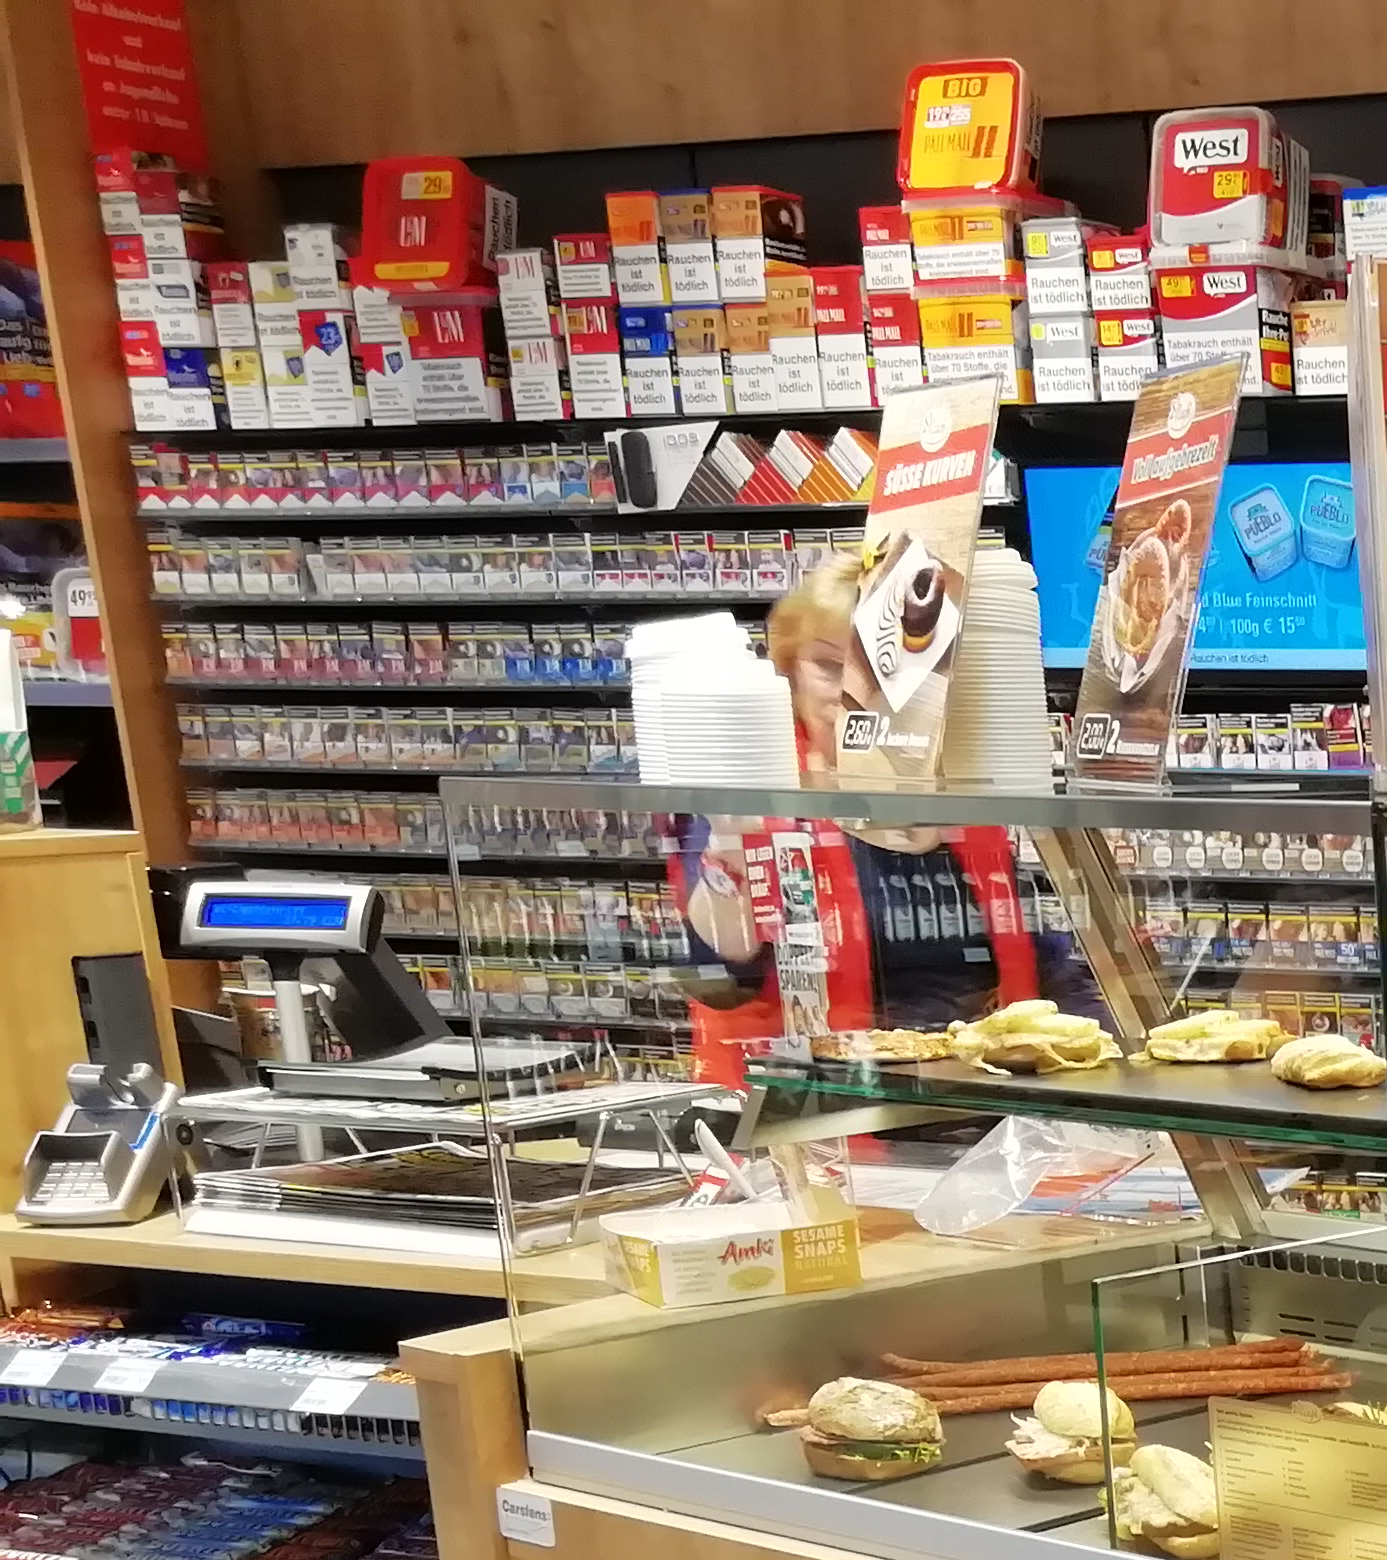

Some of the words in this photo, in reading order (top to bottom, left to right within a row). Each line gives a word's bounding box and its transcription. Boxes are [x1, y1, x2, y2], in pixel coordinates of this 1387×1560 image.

[948, 79, 982, 97] BIG
[1182, 135, 1240, 159] West
[1054, 234, 1078, 242] West
[865, 250, 907, 259] Rauchen
[616, 255, 657, 266] Rauchen
[881, 262, 892, 272] ist
[622, 280, 654, 292] tödlich
[675, 280, 708, 291] tödlich
[725, 276, 757, 288] tödlich
[872, 275, 904, 286] tödlich
[1032, 278, 1079, 288] Rauchen
[1095, 280, 1143, 289] Rauchen
[1207, 276, 1241, 289] West
[1031, 295, 1042, 303] ist
[1045, 292, 1084, 303] tödlich
[1094, 296, 1107, 305] ist
[1109, 294, 1148, 305] tödlich
[1051, 327, 1080, 337] West
[1126, 322, 1150, 331] West
[1168, 339, 1218, 349] Tabakrauch
[1220, 337, 1252, 347] enthält
[772, 354, 816, 365] Rauchen
[820, 351, 864, 362] Rauchen
[928, 352, 975, 361] Tabakrauch
[977, 350, 1009, 359] enthält
[1171, 352, 1190, 361] über
[875, 357, 918, 369] Rauchen
[931, 363, 949, 373] über
[1297, 358, 1346, 370] Rauchen
[678, 367, 720, 378] Rauchen
[733, 365, 774, 376] Rauchen
[788, 368, 801, 378] ist
[837, 366, 849, 377] ist
[891, 371, 903, 381] ist
[1039, 366, 1085, 377] Rauchen
[748, 378, 760, 388] ist
[1311, 373, 1348, 385] tödlich
[694, 380, 706, 390] ist
[778, 381, 813, 393] tödlich
[827, 379, 862, 391] tödlich
[1038, 382, 1050, 391] ist
[1053, 380, 1090, 391] tödlich
[1103, 381, 1115, 391] ist
[685, 393, 718, 403] tödlich
[883, 463, 924, 496] SÜSSE
[922, 450, 976, 486] KURVEN
[1311, 504, 1349, 524] PUEBLO
[1245, 513, 1282, 540] PUEBLO
[1213, 593, 1242, 607] Blue
[1246, 592, 1317, 607] Feinschnitt
[793, 1225, 845, 1243] SESAME
[794, 1240, 847, 1259] SNAPS
